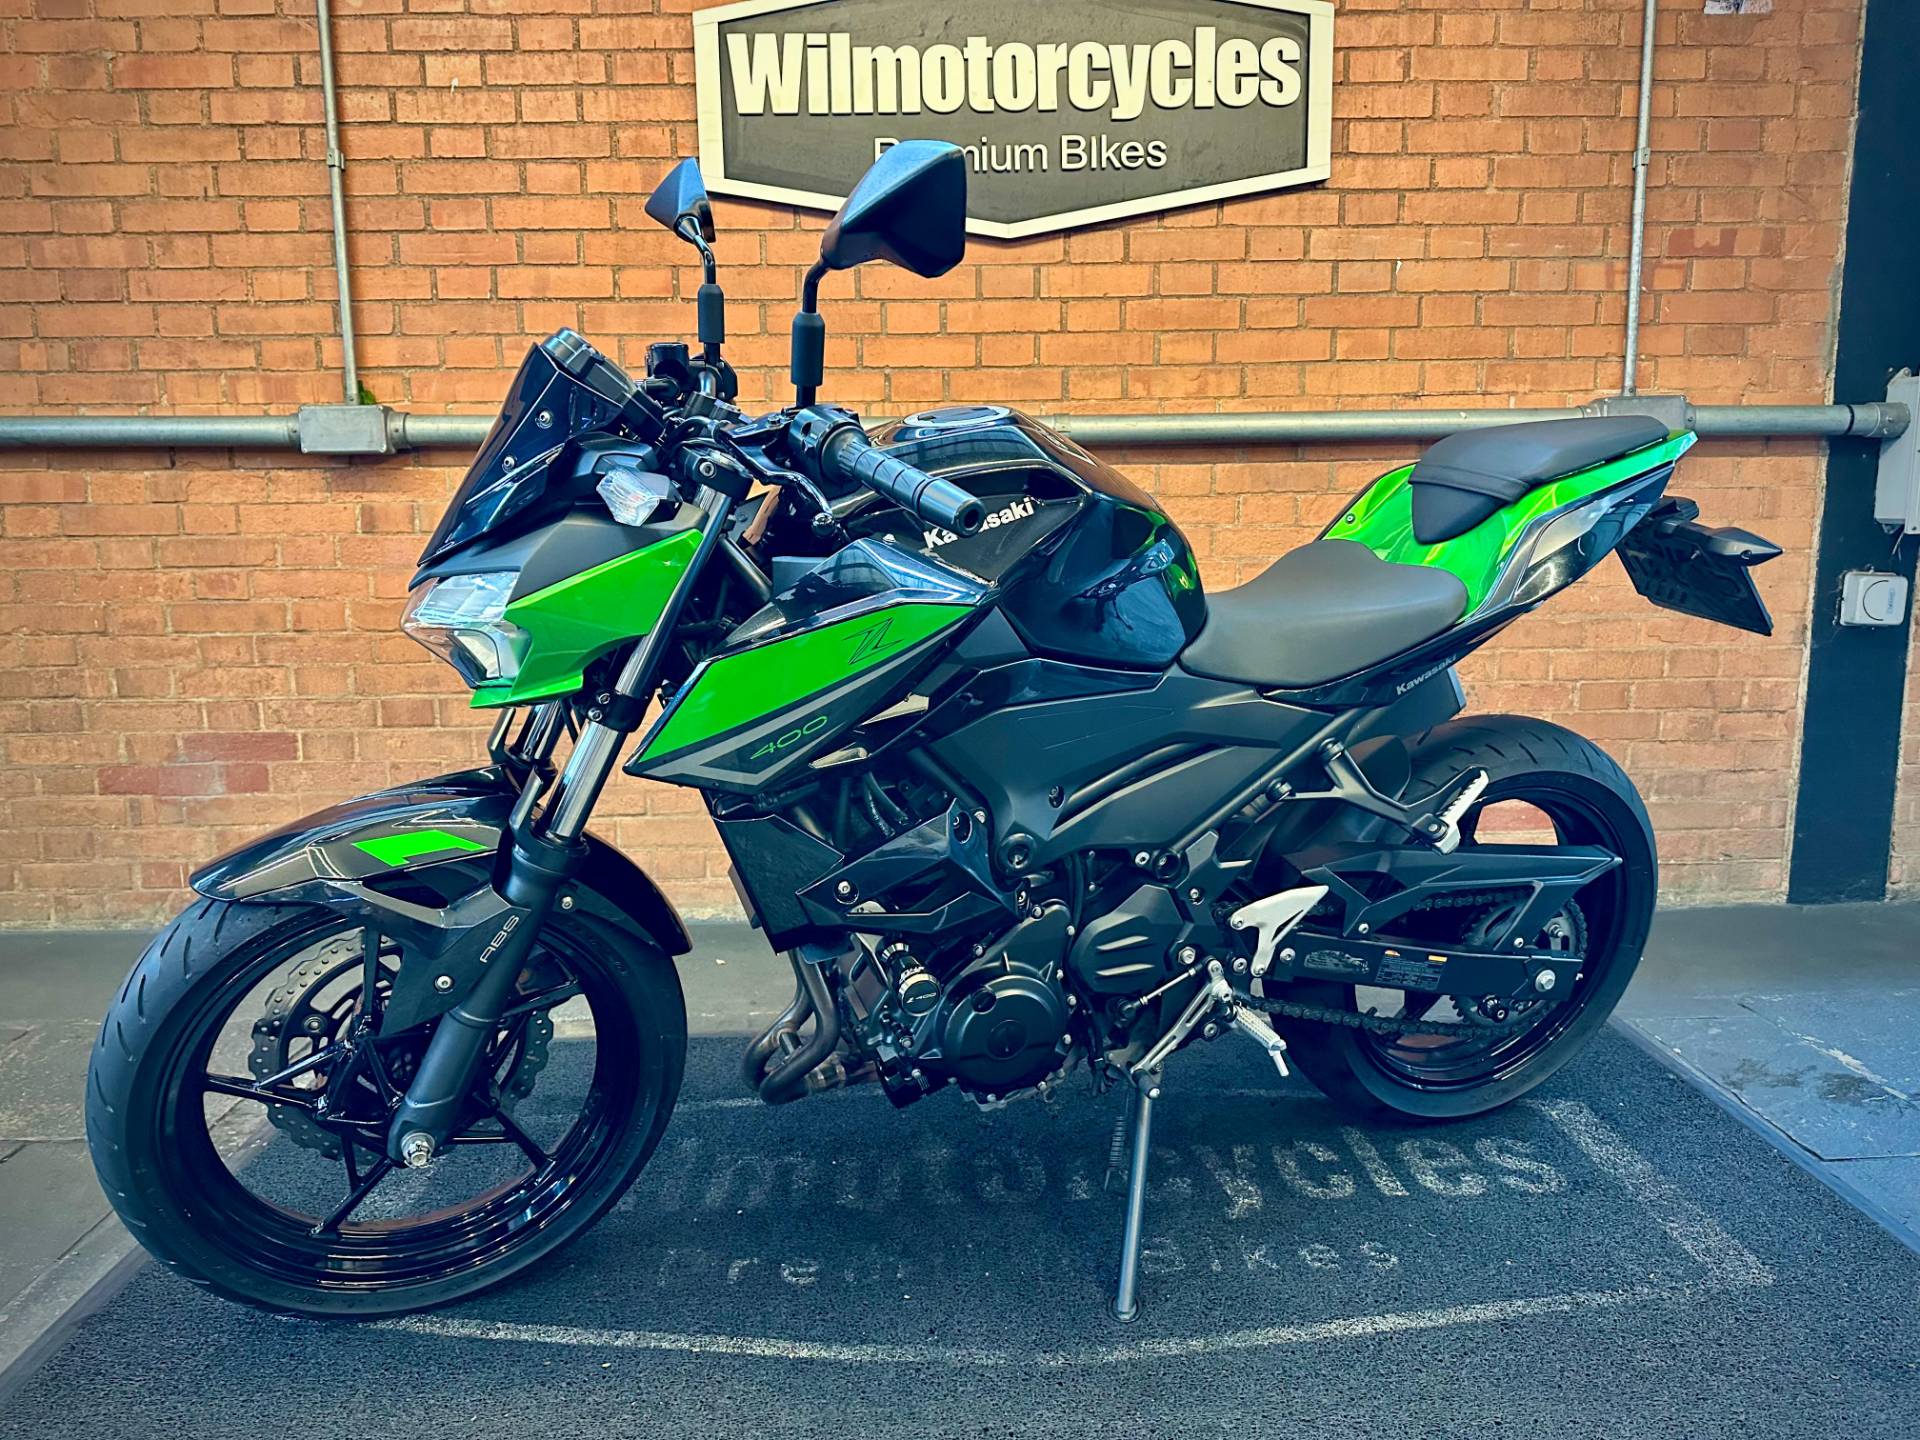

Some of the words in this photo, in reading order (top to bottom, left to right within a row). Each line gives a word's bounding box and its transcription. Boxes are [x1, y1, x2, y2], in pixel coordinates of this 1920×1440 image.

[726, 26, 1301, 119] Wilmotorcycles
[923, 496, 1035, 549] Kasaki
[1397, 654, 1457, 695] Kawasaki
[749, 715, 829, 760] 400
[480, 915, 519, 963] ABS
